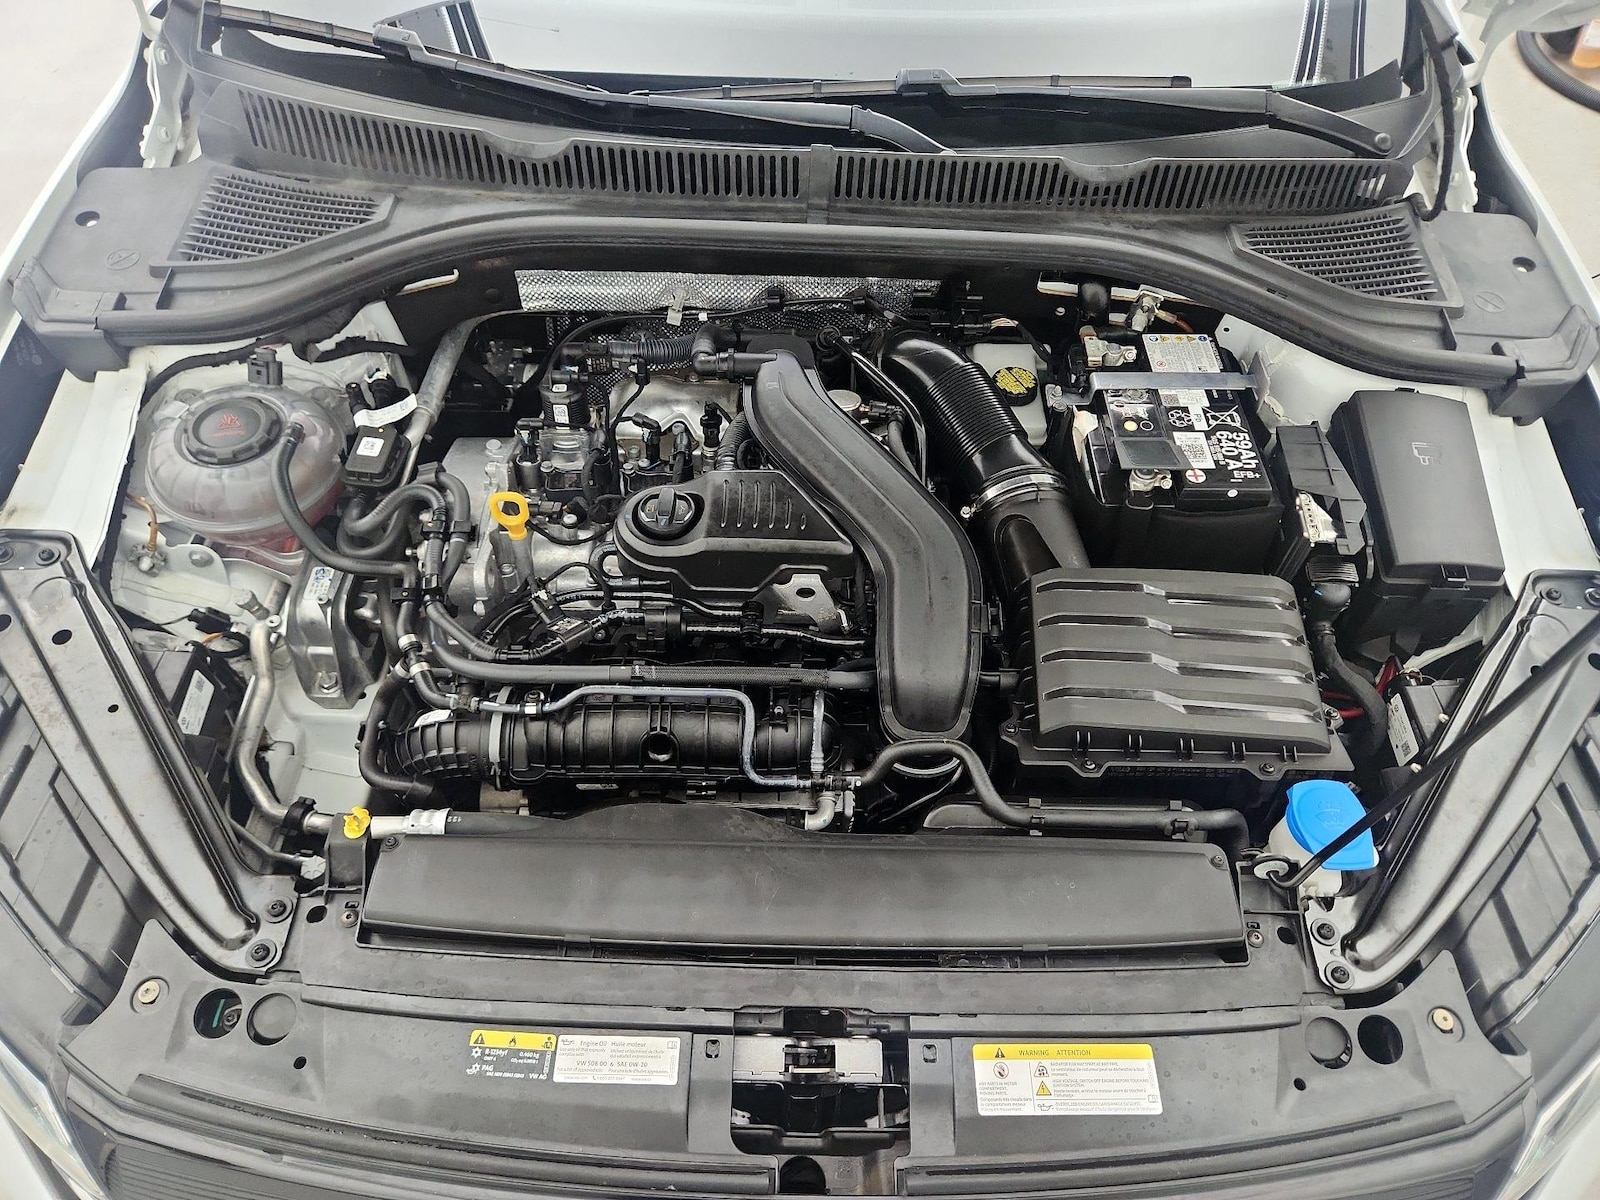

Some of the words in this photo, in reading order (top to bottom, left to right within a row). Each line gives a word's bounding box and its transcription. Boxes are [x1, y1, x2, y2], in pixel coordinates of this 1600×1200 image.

[1215, 430, 1239, 456] 640
[1232, 431, 1259, 469] 59Ah
[1224, 458, 1244, 470] A
[1233, 470, 1261, 479] EFB+
